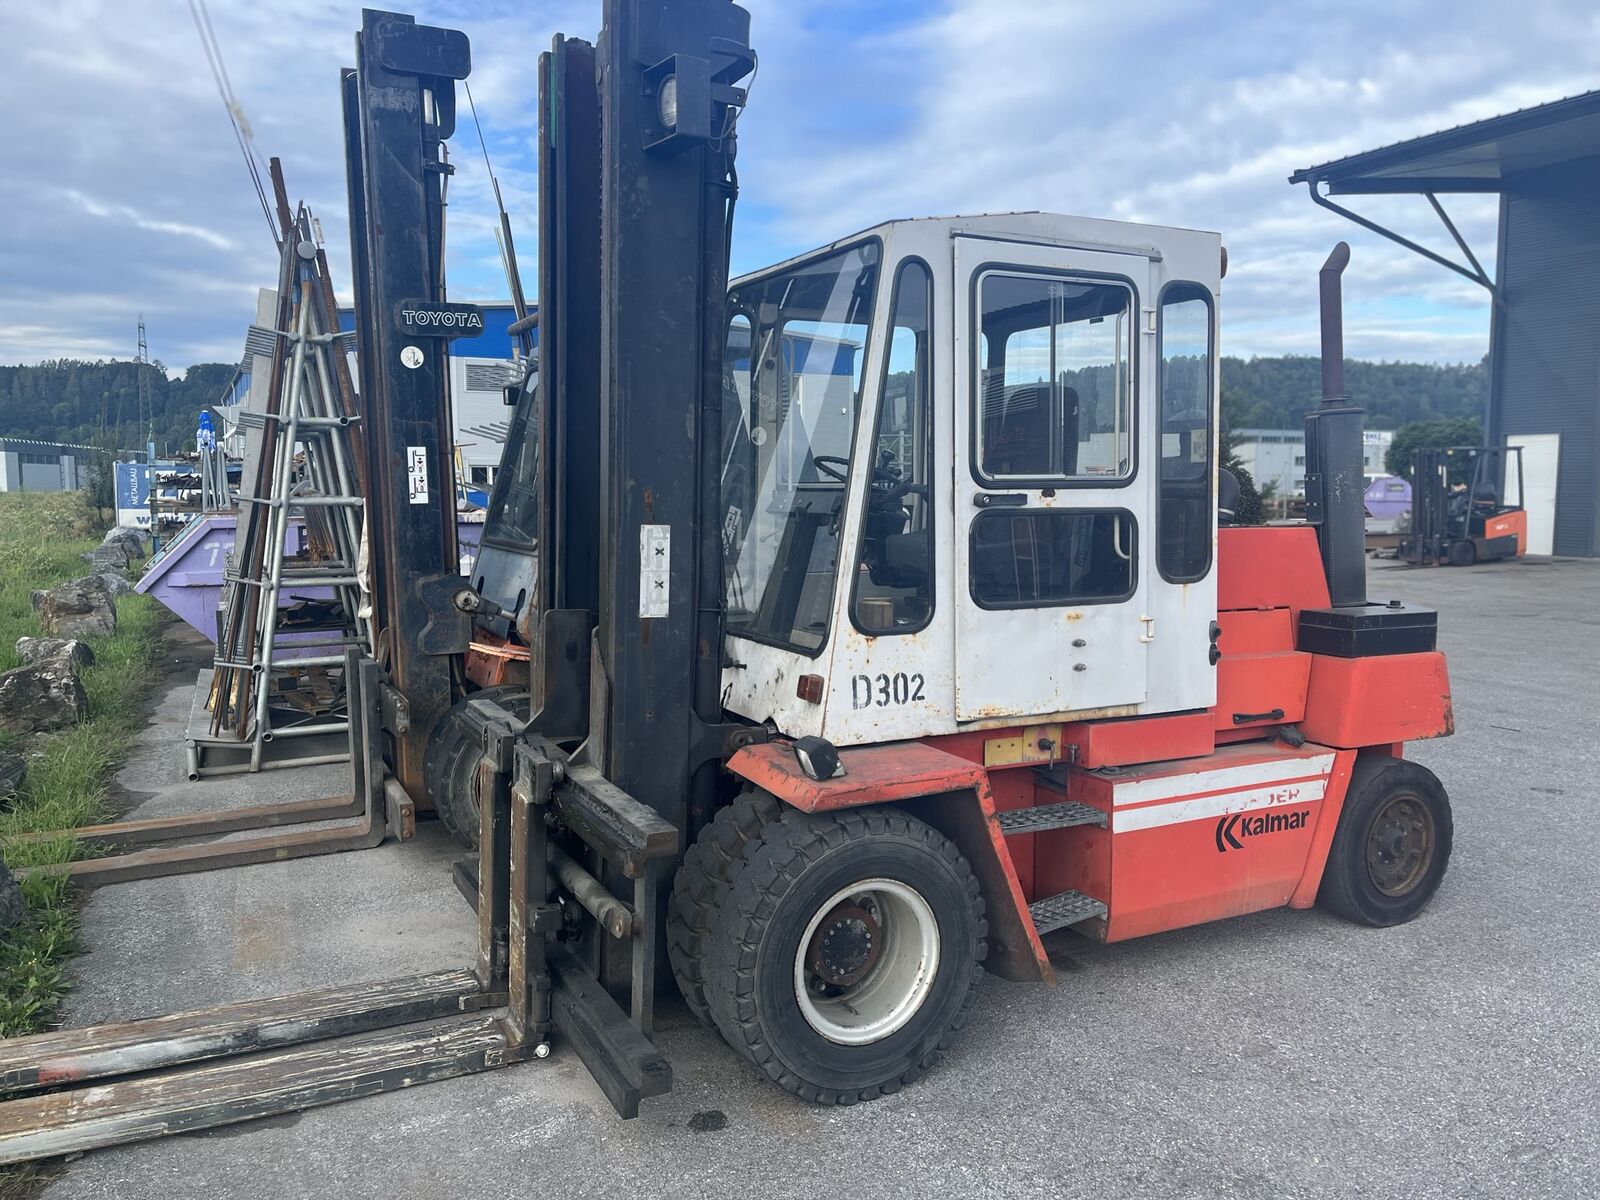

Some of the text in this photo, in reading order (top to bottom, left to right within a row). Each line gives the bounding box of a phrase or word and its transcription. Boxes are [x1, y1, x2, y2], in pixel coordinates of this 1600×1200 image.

[402, 310, 482, 328] TOYOTA
[129, 467, 139, 505] METALLBAU
[851, 672, 926, 710] D302
[1241, 810, 1310, 837] Kalmar
